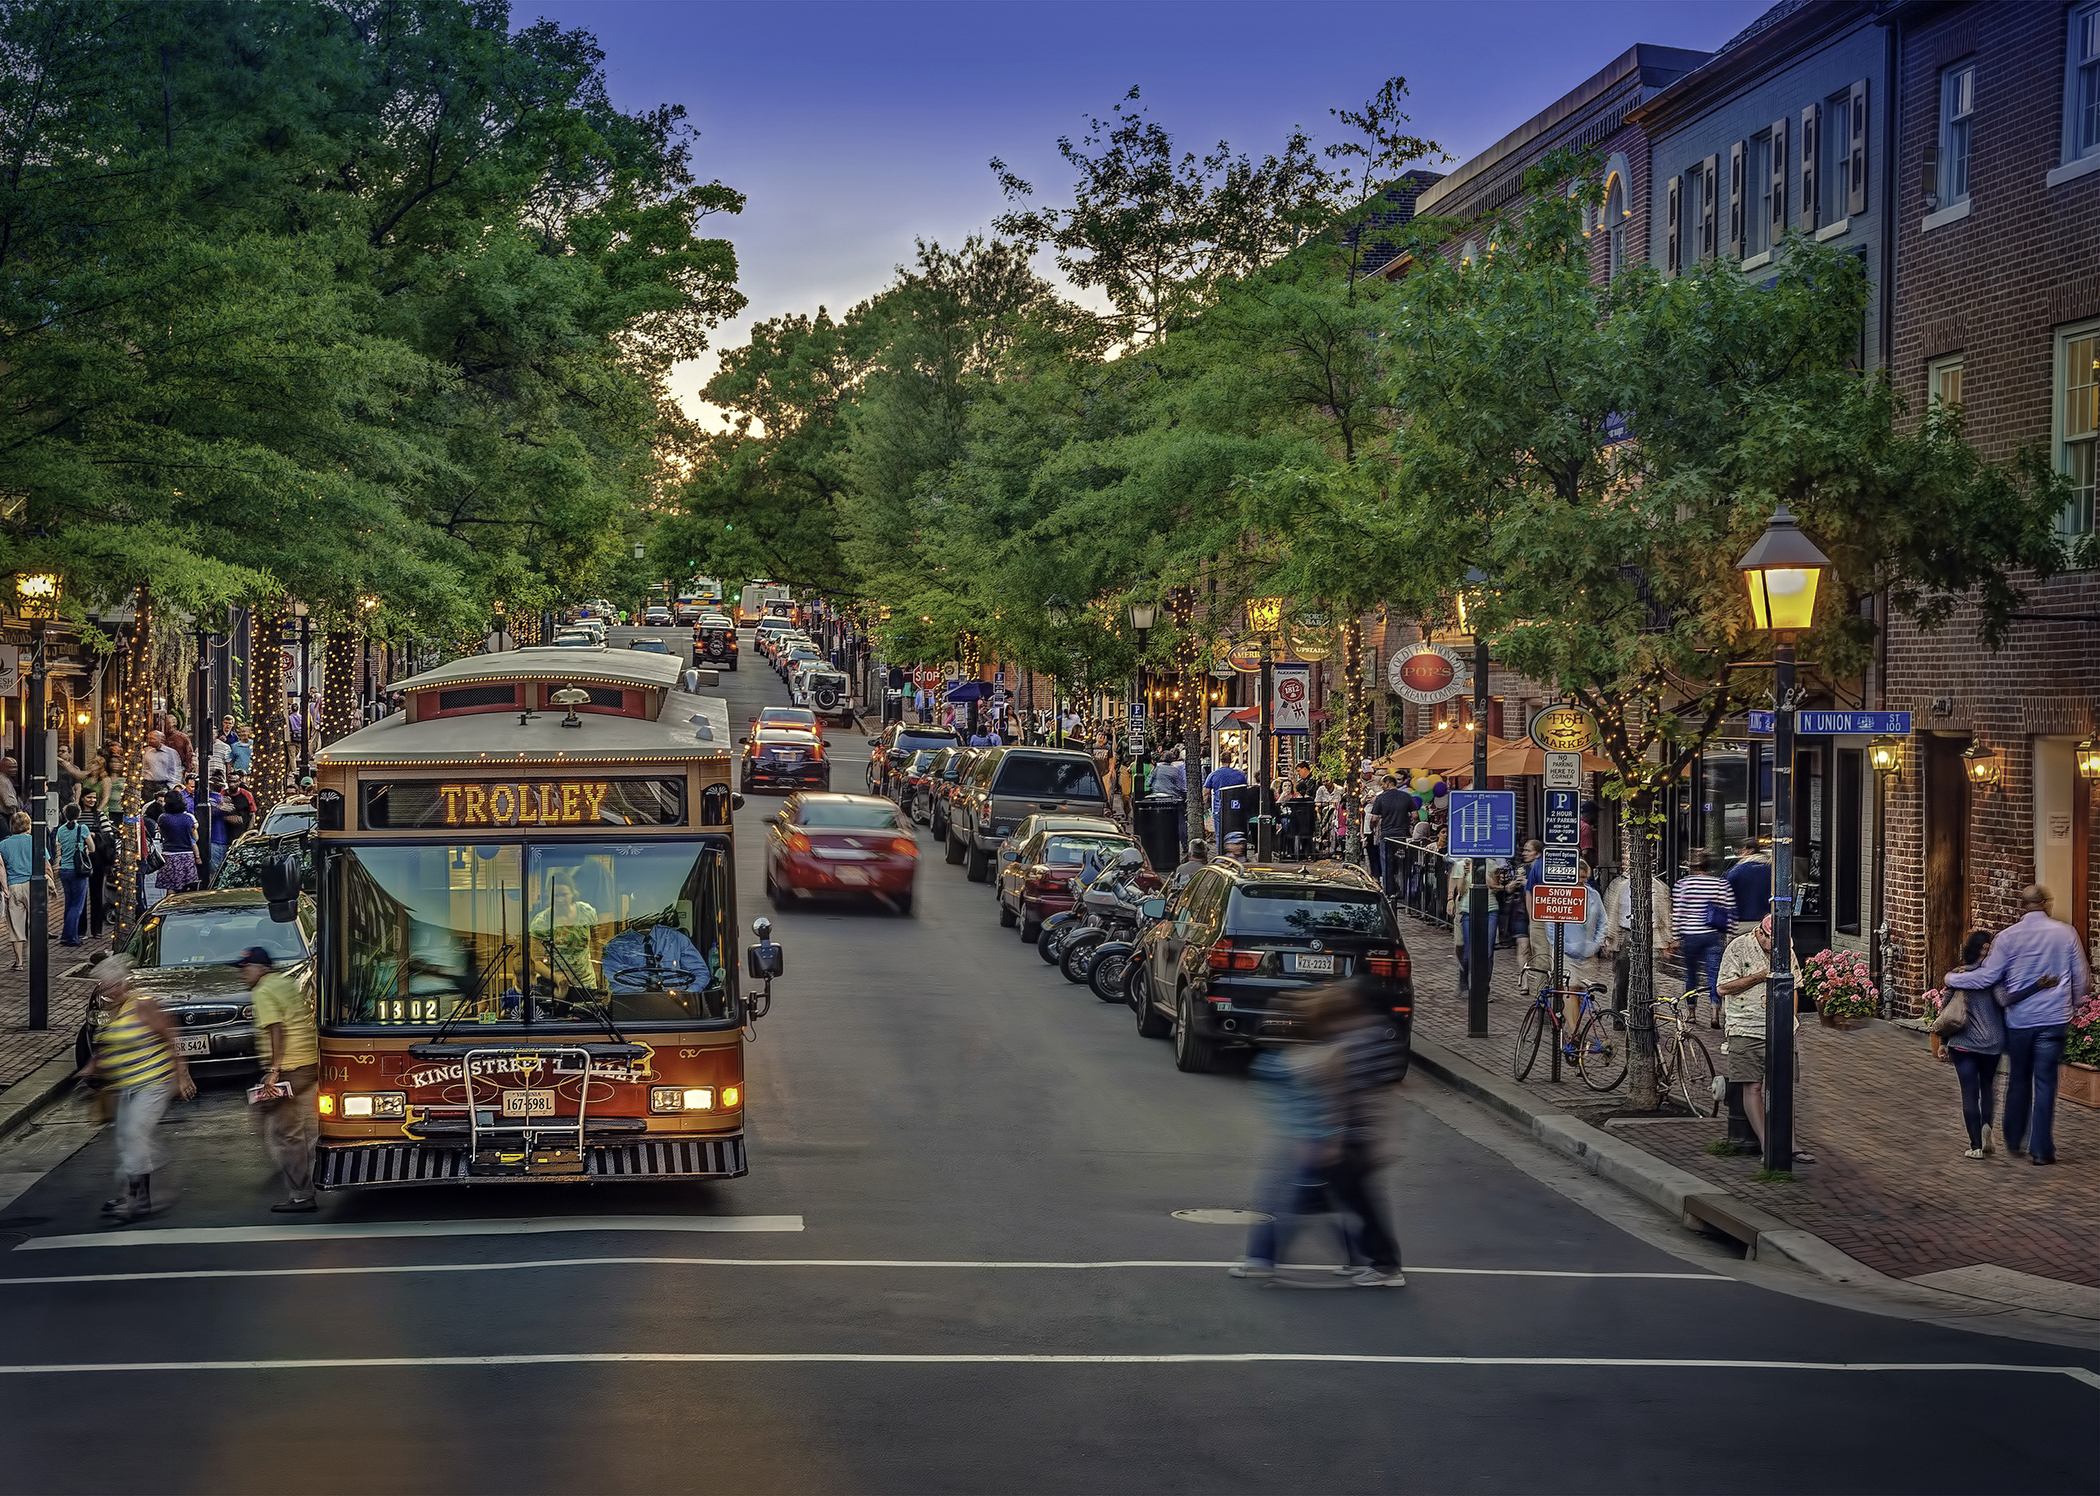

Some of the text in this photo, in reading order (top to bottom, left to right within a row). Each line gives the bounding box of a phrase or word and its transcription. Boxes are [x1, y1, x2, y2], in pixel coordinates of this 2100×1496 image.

[1393, 650, 1410, 668] OLD
[1415, 645, 1461, 669] FASHIONED
[915, 671, 939, 681] STOP
[1403, 667, 1452, 677] POP'S
[1285, 685, 1300, 694] 1812
[1391, 672, 1462, 701] ICE CREAM COMPANY
[1546, 713, 1584, 728] FISH
[1804, 714, 1900, 731] N UNION ST
[1886, 723, 1901, 731] 100
[1540, 732, 1591, 749] MARKET
[440, 784, 607, 823] TROLLEY
[1557, 794, 1568, 809] P
[1549, 888, 1572, 896] SNOW
[1535, 896, 1584, 906] EMERGENCY
[1546, 906, 1573, 914] ROUTE
[380, 1000, 437, 1020] 1302
[188, 1041, 206, 1050] 5424
[412, 1058, 640, 1089] KING STREET TLLEY
[507, 1098, 552, 1111] 167-698L
